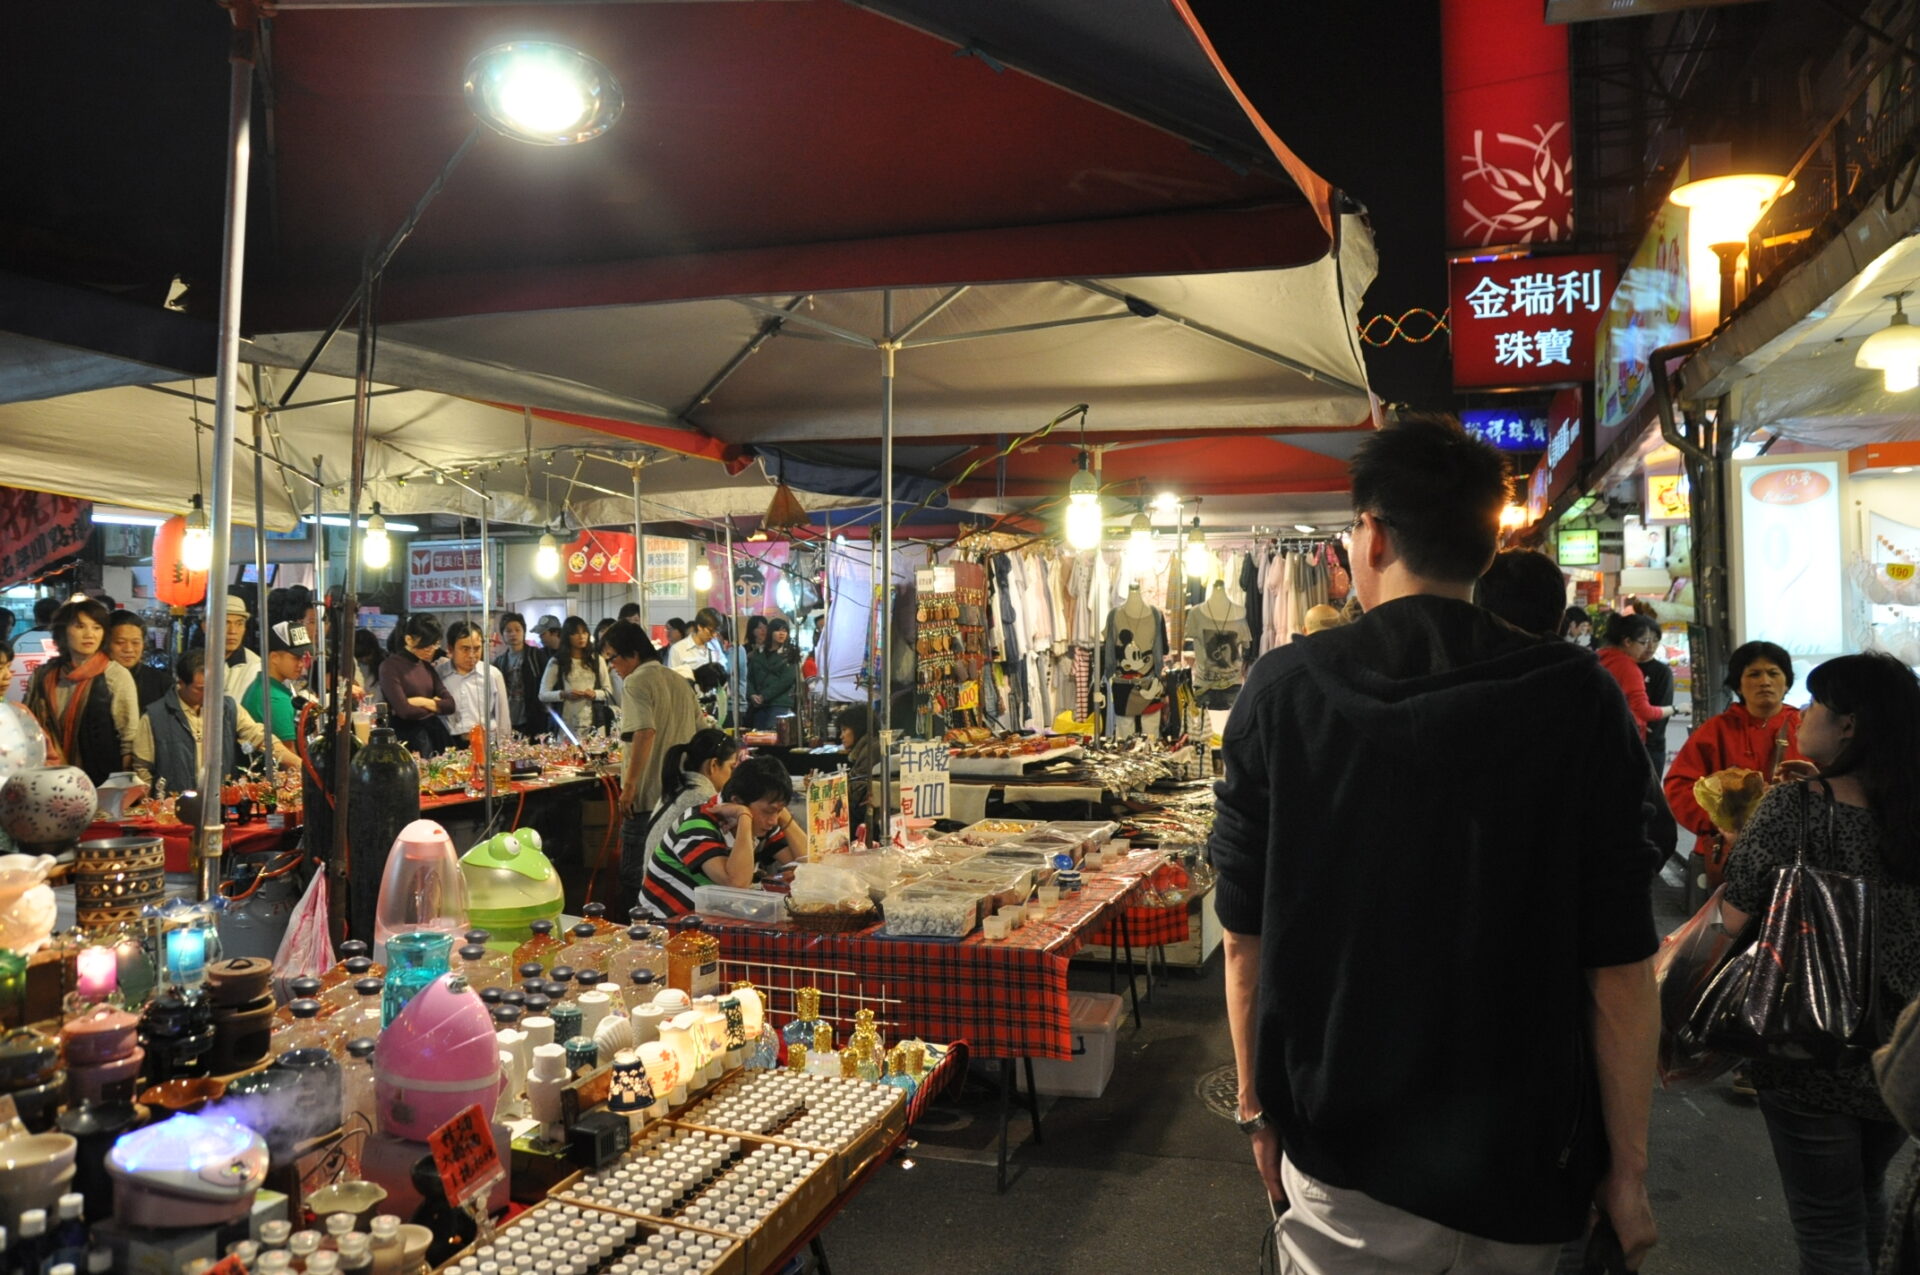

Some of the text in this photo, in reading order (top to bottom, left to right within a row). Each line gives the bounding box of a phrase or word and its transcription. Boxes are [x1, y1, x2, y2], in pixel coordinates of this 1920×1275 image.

[1465, 269, 1601, 319] 金瑞利
[1494, 328, 1574, 368] 珠寶
[1890, 566, 1909, 577] 190
[900, 744, 949, 772] 牛肉乾
[913, 783, 944, 818] 100
